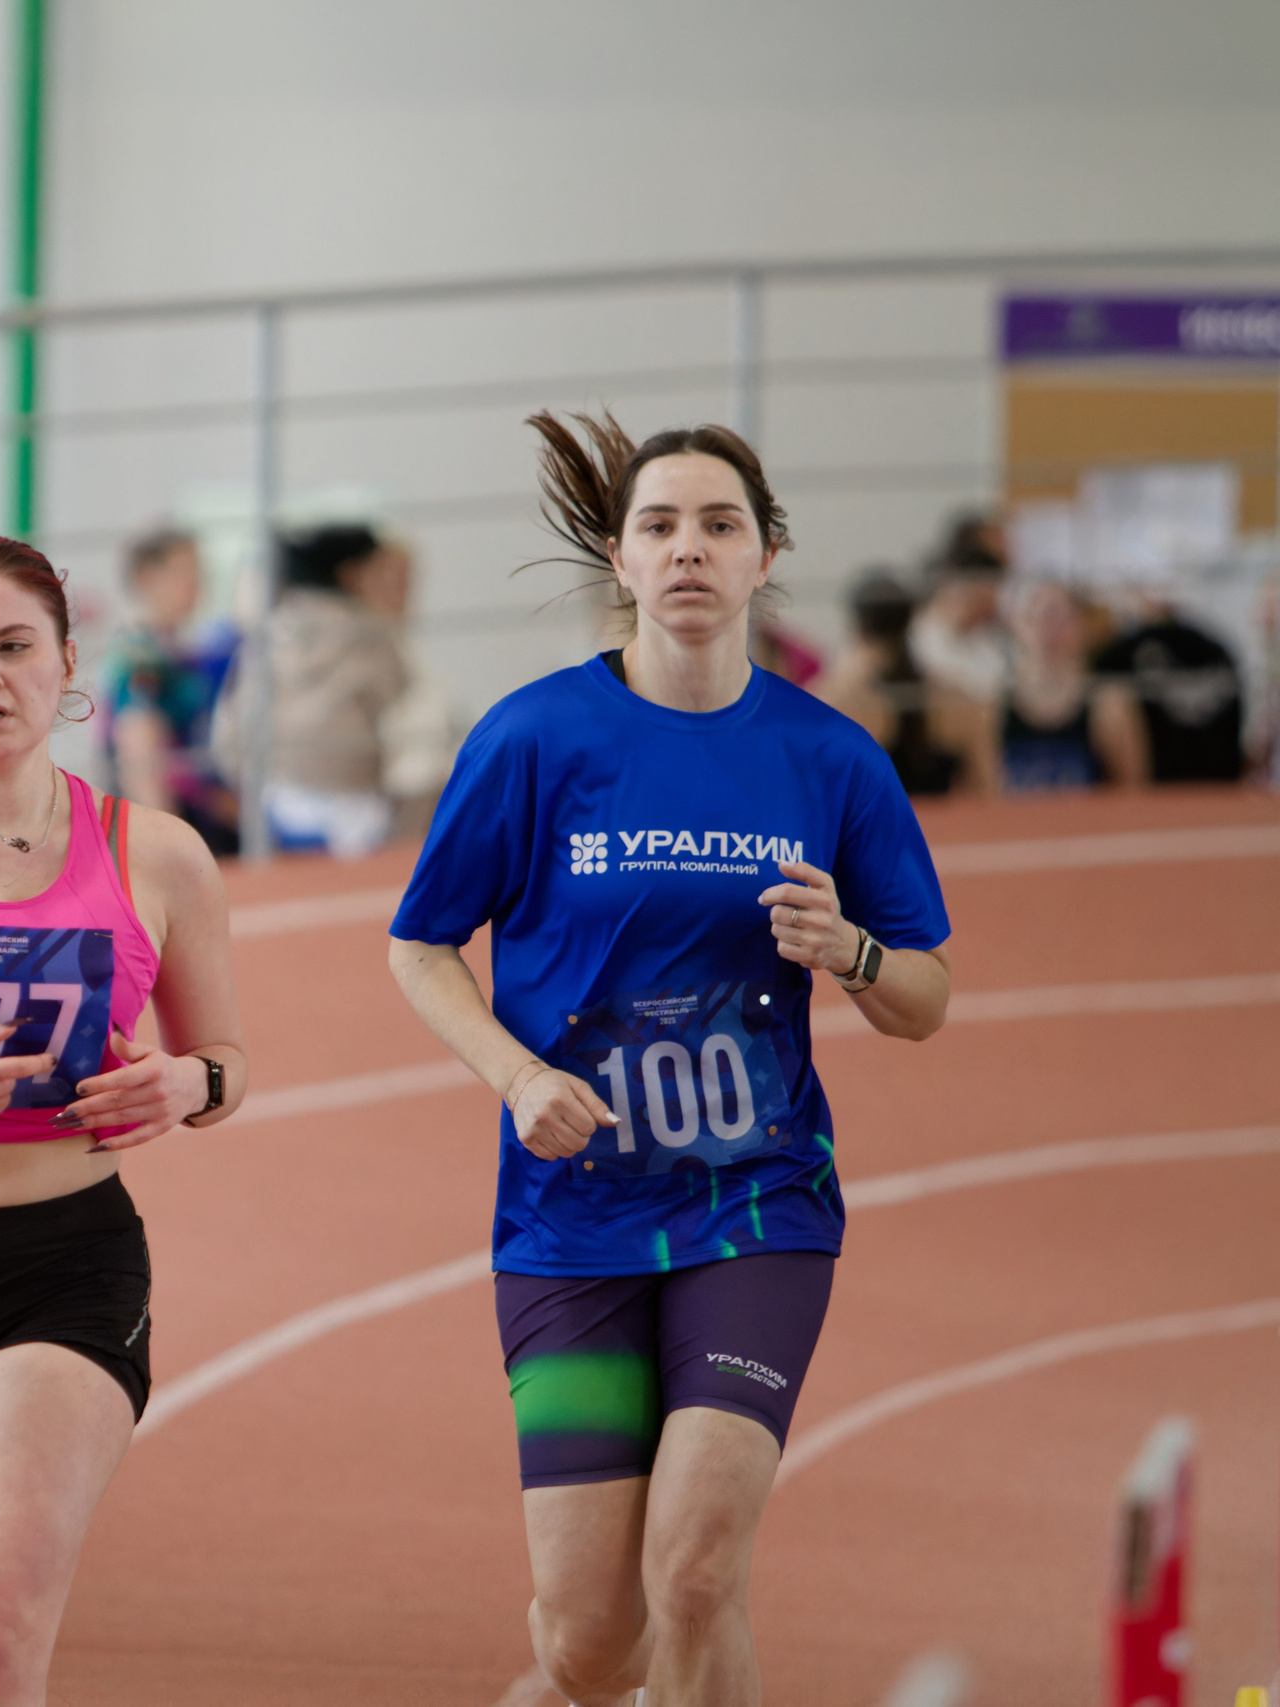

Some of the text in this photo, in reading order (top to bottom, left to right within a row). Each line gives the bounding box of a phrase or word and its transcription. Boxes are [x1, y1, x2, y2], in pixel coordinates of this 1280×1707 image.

[618, 829, 804, 864] УРАЛХИМ
[619, 860, 759, 876] ГРУППА КОМПАНИЙ
[632, 995, 698, 1008] ВСЕРОССИЙСКИЙ
[643, 1007, 690, 1017] ФЕСТИВАЛЬ
[596, 1033, 755, 1153] 100
[705, 1353, 788, 1389] УРАЛХИМ
[744, 1370, 781, 1391] FACTORY
